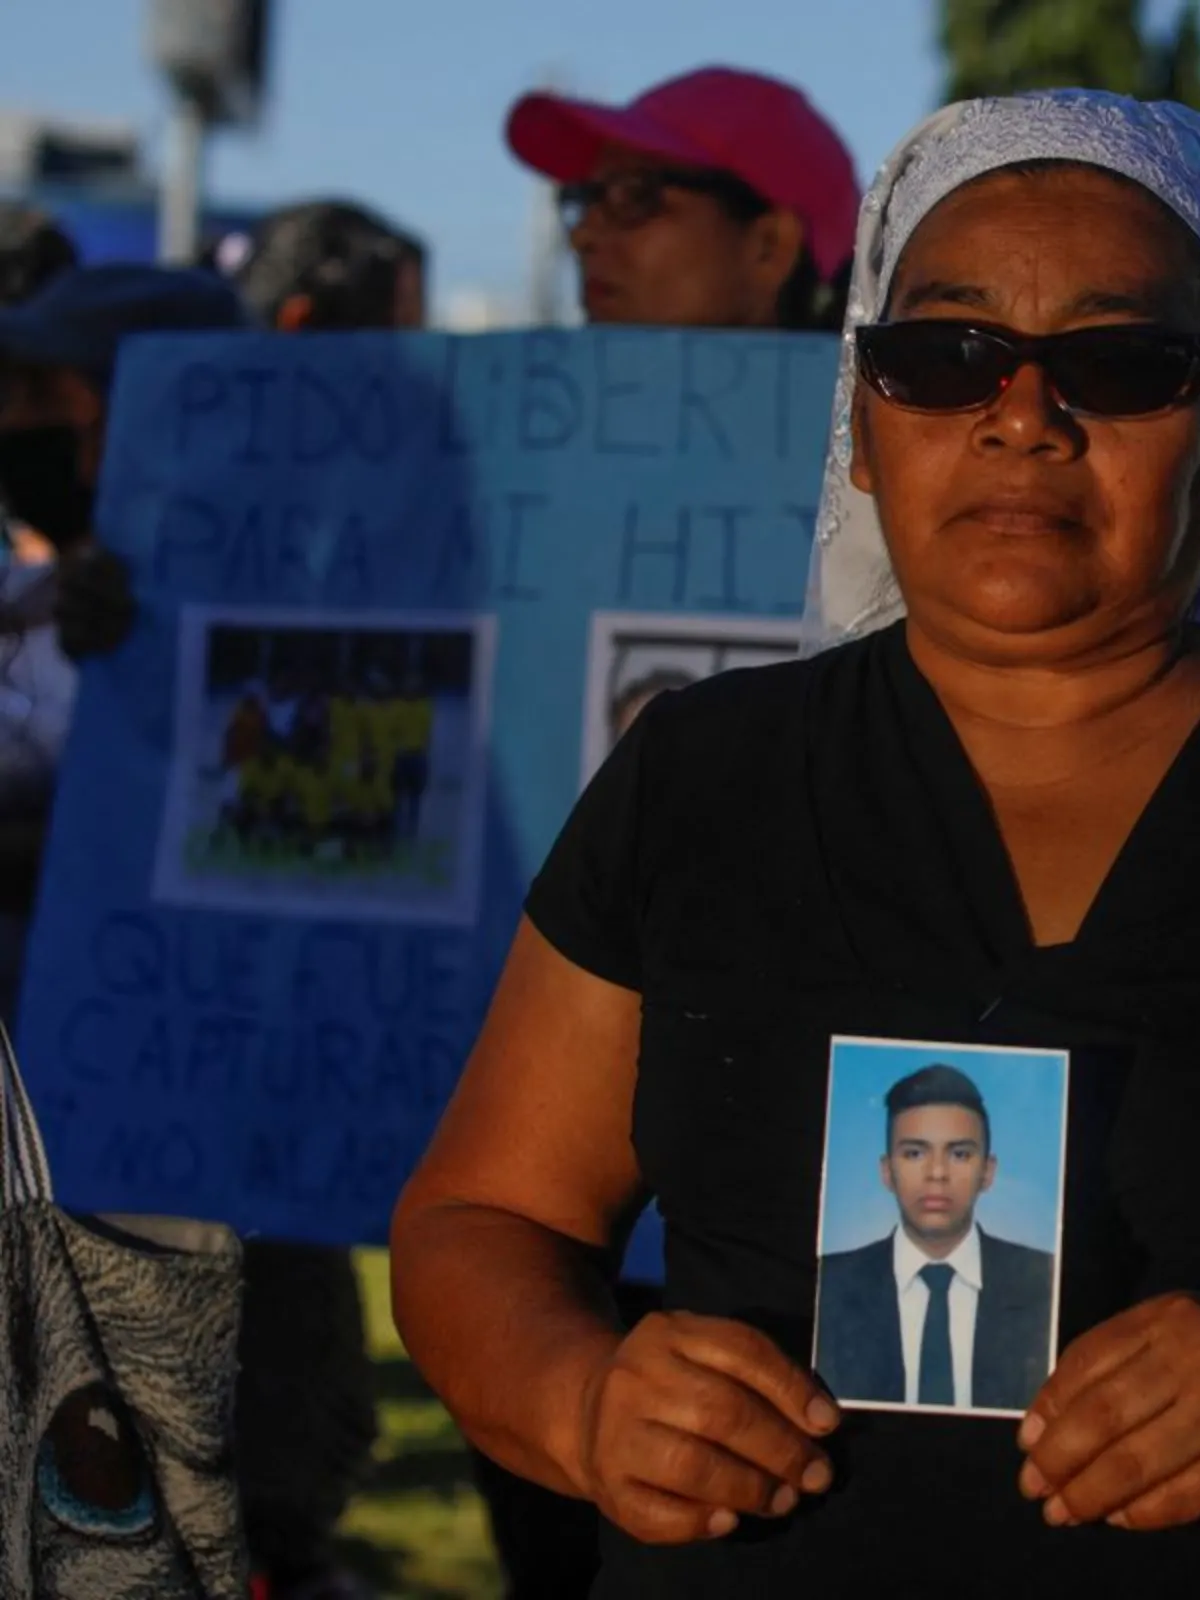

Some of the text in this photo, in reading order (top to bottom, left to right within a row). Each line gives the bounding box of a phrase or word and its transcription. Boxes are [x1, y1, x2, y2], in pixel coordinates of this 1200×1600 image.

[174, 360, 398, 465] PIDO
[90, 908, 463, 1023] QUE FUE
